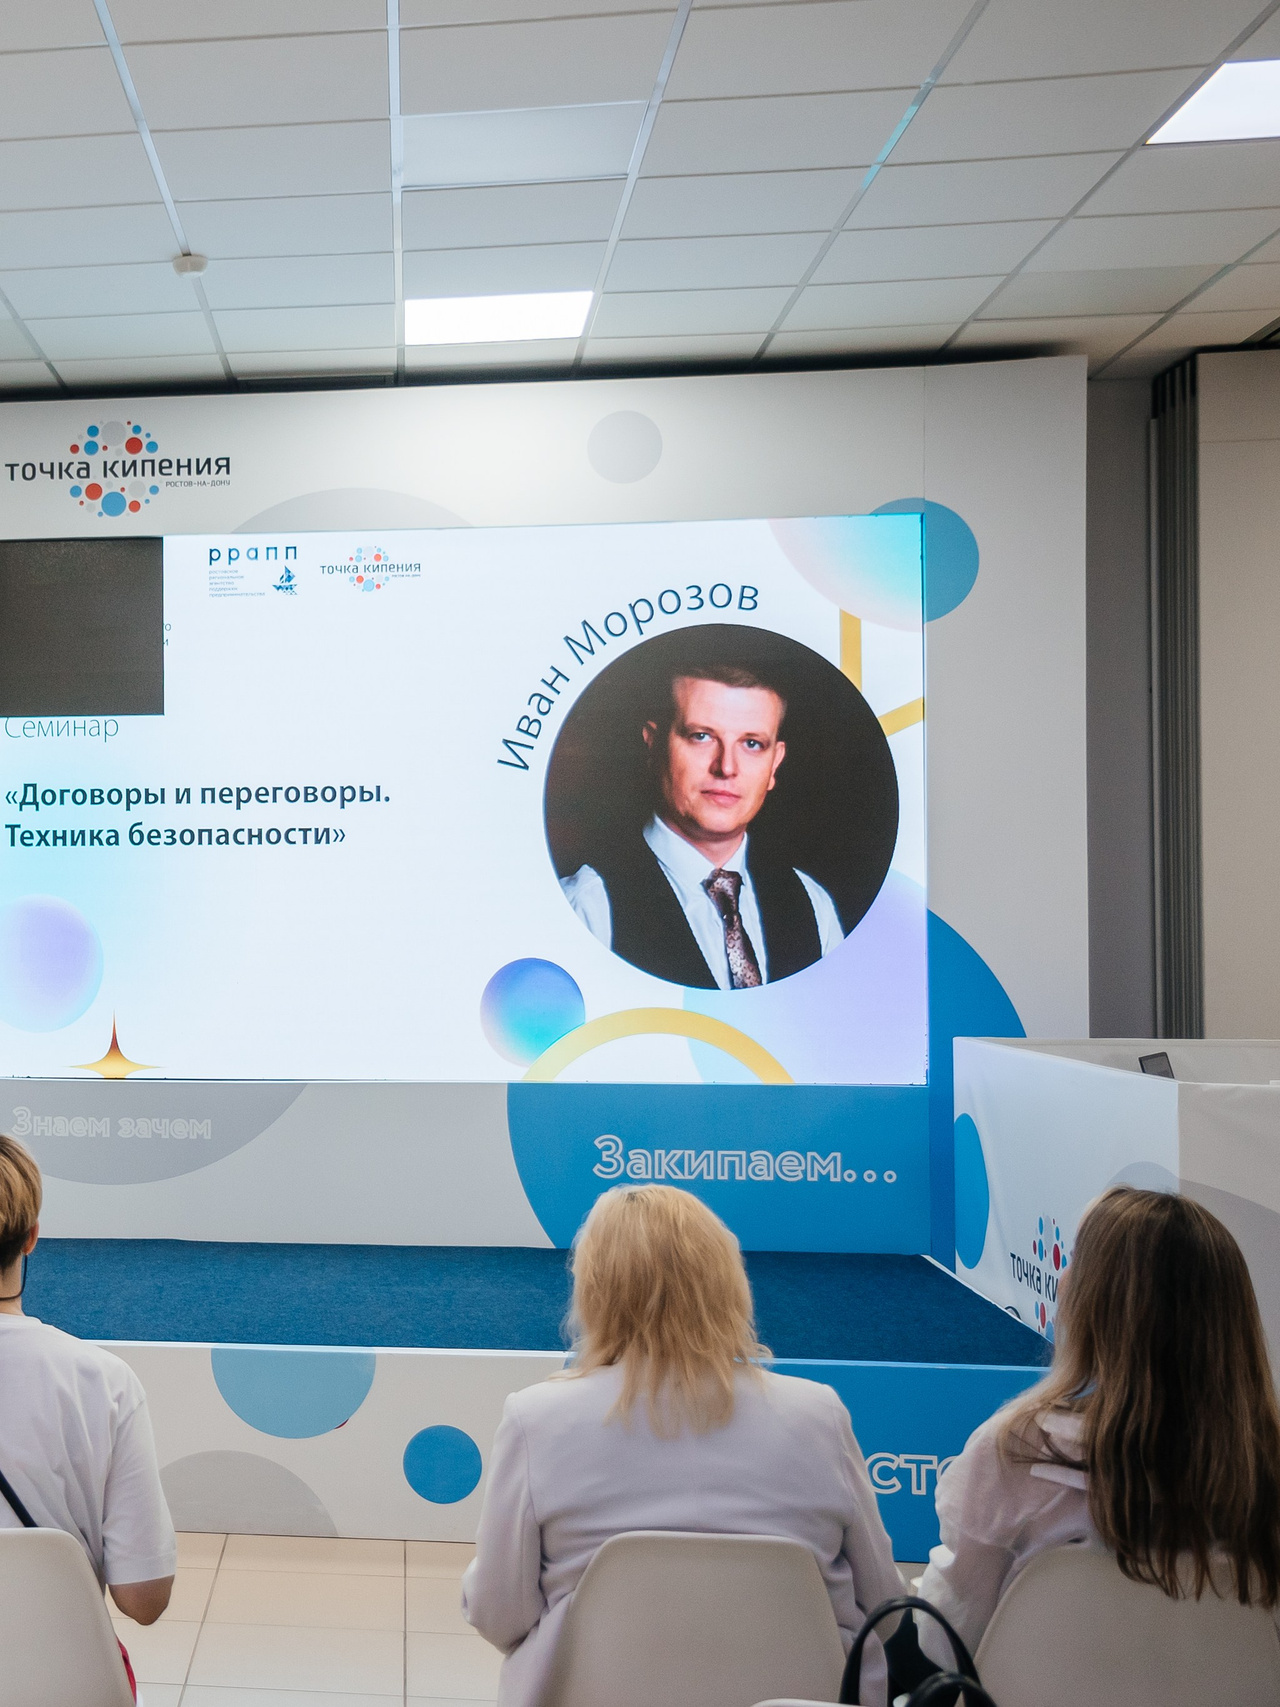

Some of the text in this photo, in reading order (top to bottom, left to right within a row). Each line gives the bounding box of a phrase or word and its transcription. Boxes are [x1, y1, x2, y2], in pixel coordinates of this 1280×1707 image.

[5, 456, 231, 482] точка кипения
[165, 480, 231, 488] РОСТОВ-НА-ДОНУ
[320, 563, 421, 575] точка кипения
[497, 583, 759, 771] Иван Морозов
[4, 716, 119, 743] Семинар
[5, 783, 391, 812] «Договоры и переговоры.
[5, 822, 346, 848] Техника безопасности»
[12, 1106, 212, 1140] Знаем зачем
[592, 1134, 897, 1183] Закипаем...
[1010, 1252, 1042, 1295] точка
